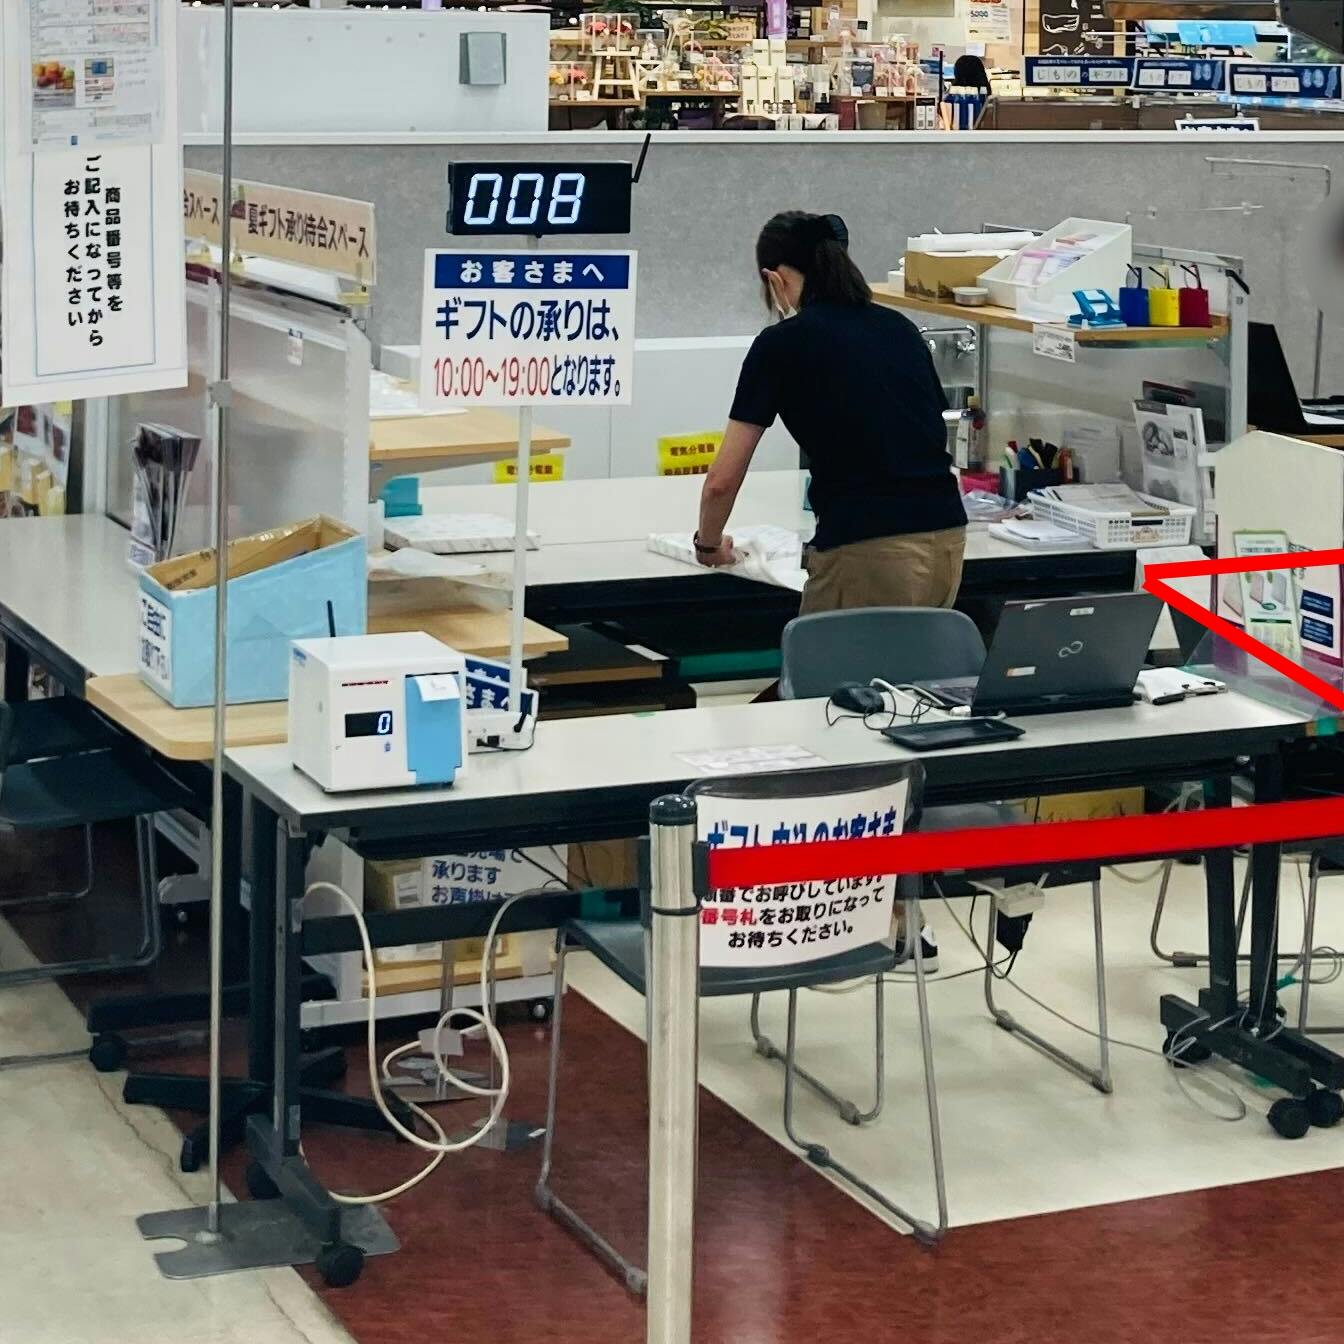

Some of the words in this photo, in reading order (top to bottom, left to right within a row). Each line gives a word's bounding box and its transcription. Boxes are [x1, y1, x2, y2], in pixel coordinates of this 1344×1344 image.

[462, 172, 587, 225] 008
[84, 156, 104, 348] ご記入になってから
[104, 187, 124, 313] 商品番号等を
[247, 202, 370, 258] 夏ギフト承り待合スペース
[64, 179, 84, 328] お待ちください
[459, 259, 606, 285] お客さまへ
[434, 298, 621, 343] ギフトの承りは、
[377, 711, 391, 734] 0
[431, 859, 502, 885] 承ります
[699, 886, 885, 926] 番号札をお取りになって
[727, 919, 854, 949] お待ちください。
